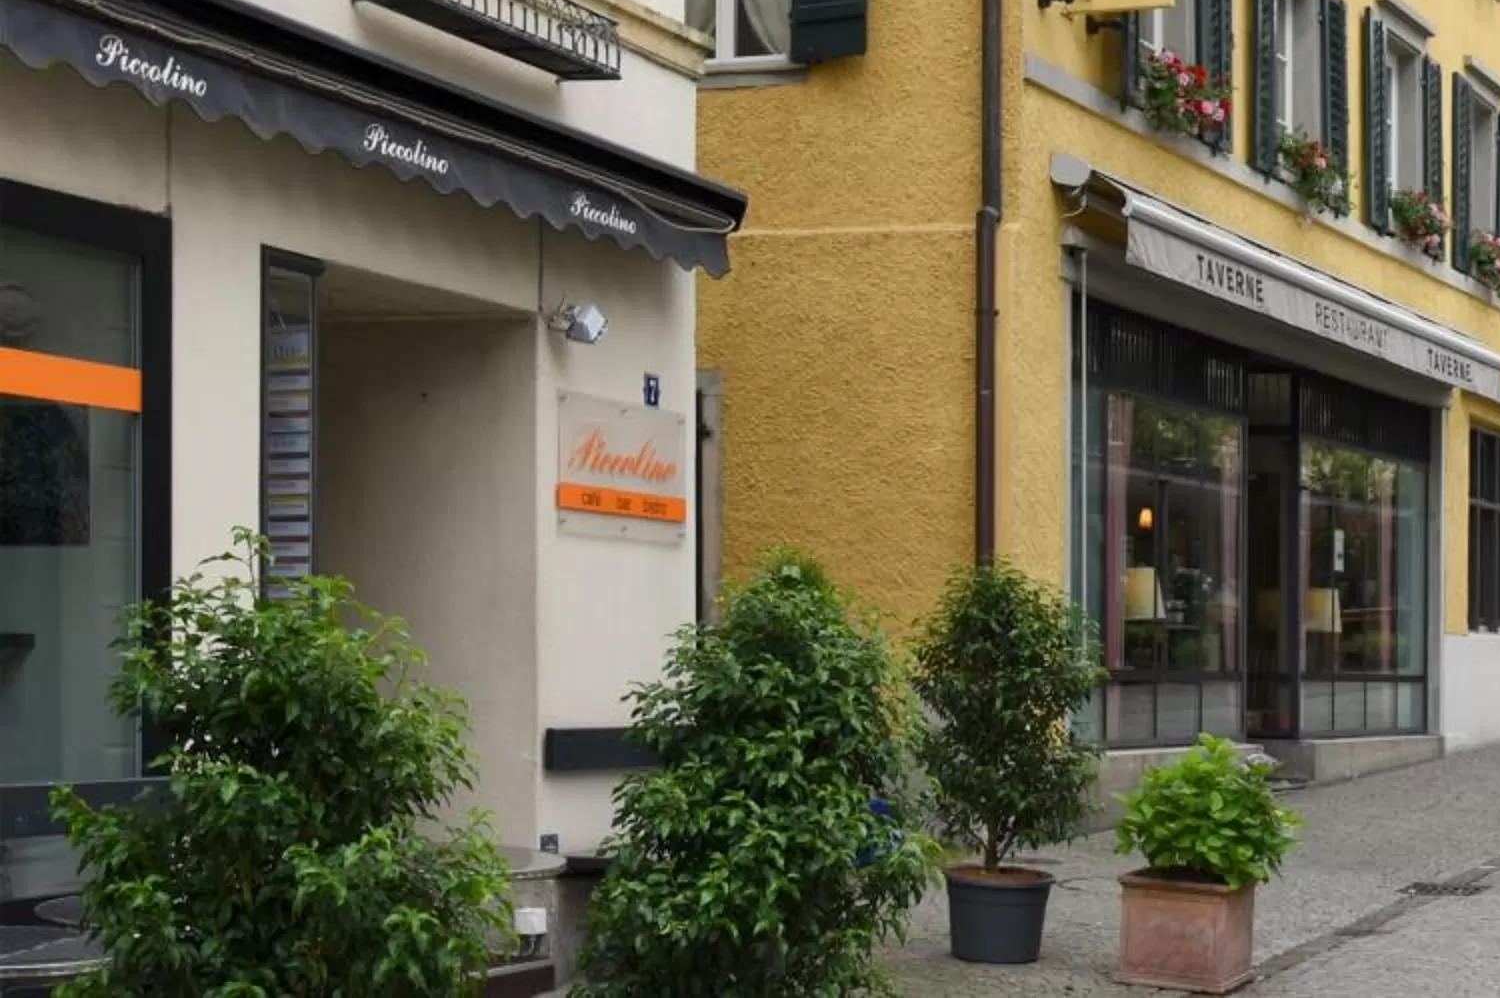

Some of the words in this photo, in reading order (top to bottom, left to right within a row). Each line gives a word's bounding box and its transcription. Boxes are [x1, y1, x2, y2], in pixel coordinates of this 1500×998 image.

[95, 33, 208, 97] Piccolino
[363, 122, 449, 175] Piccolino
[569, 190, 637, 235] Piccolino
[1196, 253, 1264, 303] TAVERNE
[1426, 347, 1473, 383] TAVERNE
